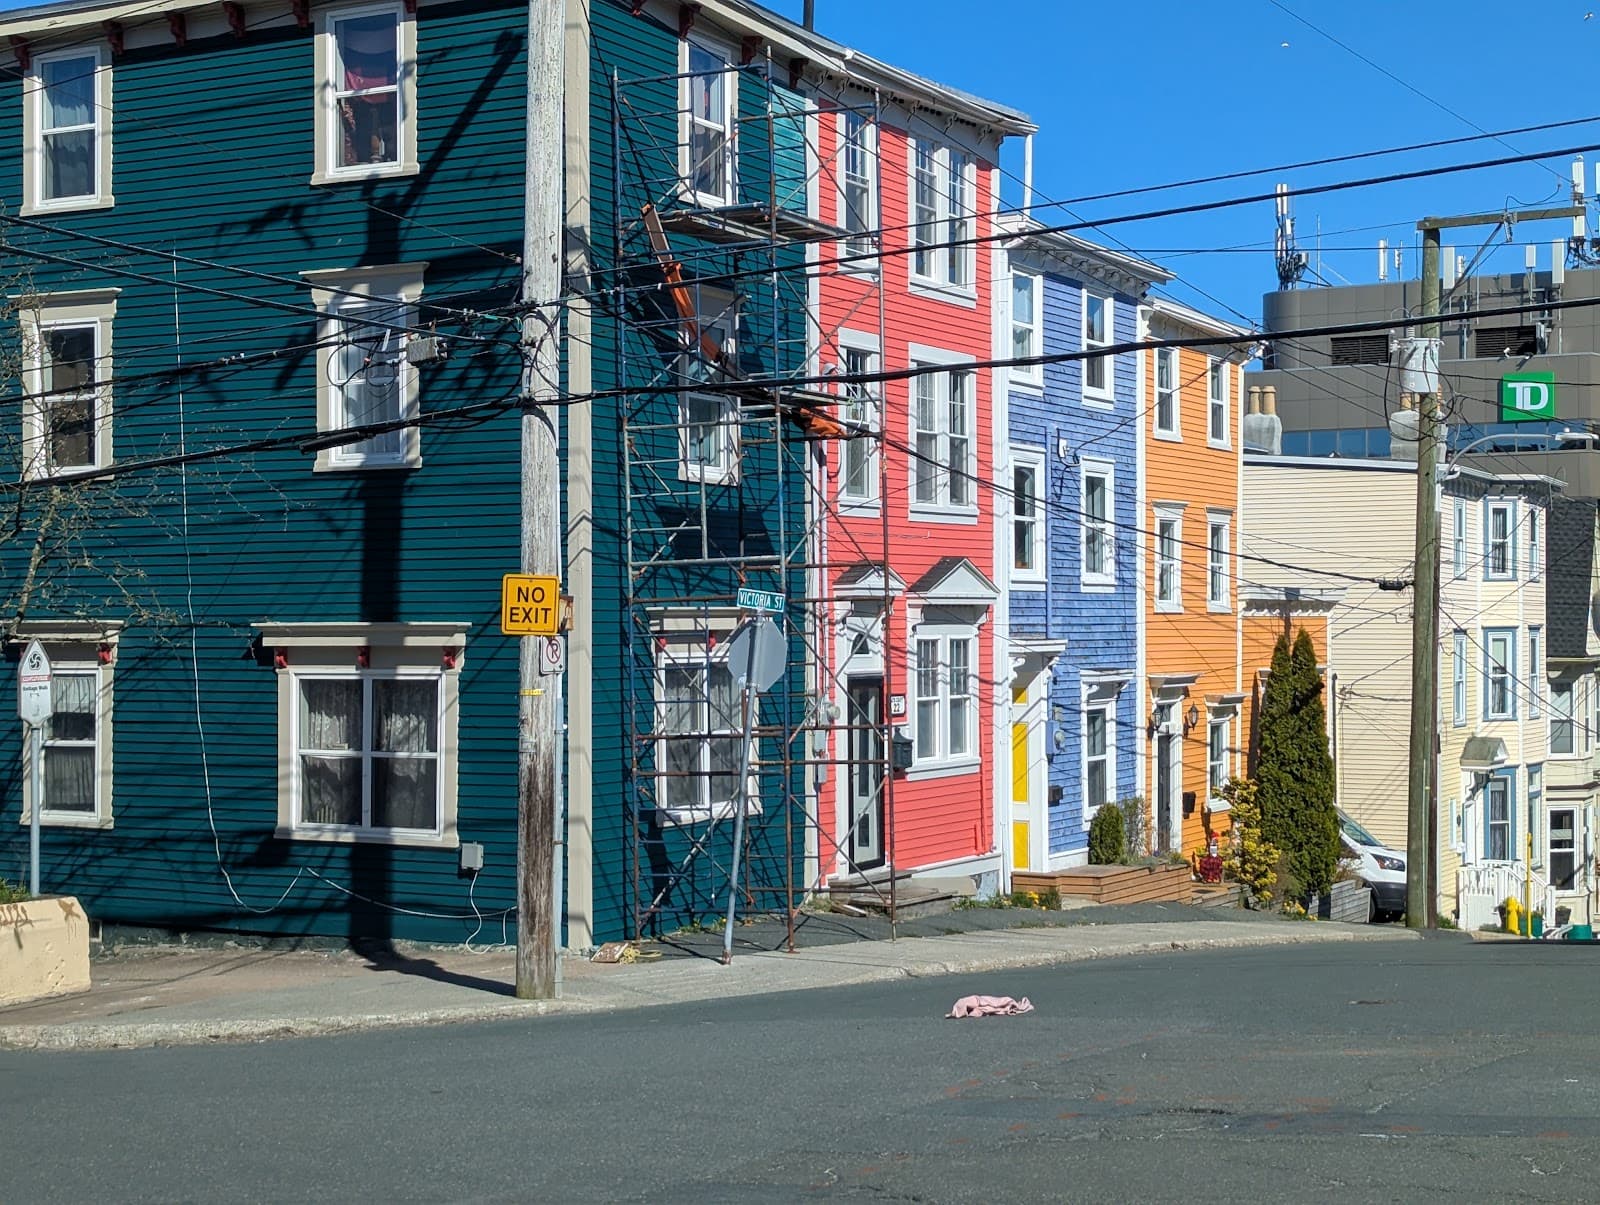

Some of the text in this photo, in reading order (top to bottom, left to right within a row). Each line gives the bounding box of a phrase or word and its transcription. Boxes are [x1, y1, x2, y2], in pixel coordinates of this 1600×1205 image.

[1507, 382, 1549, 410] TD
[517, 586, 545, 603] NO
[740, 591, 783, 609] VICTORIA ST
[509, 607, 552, 624] EXIT
